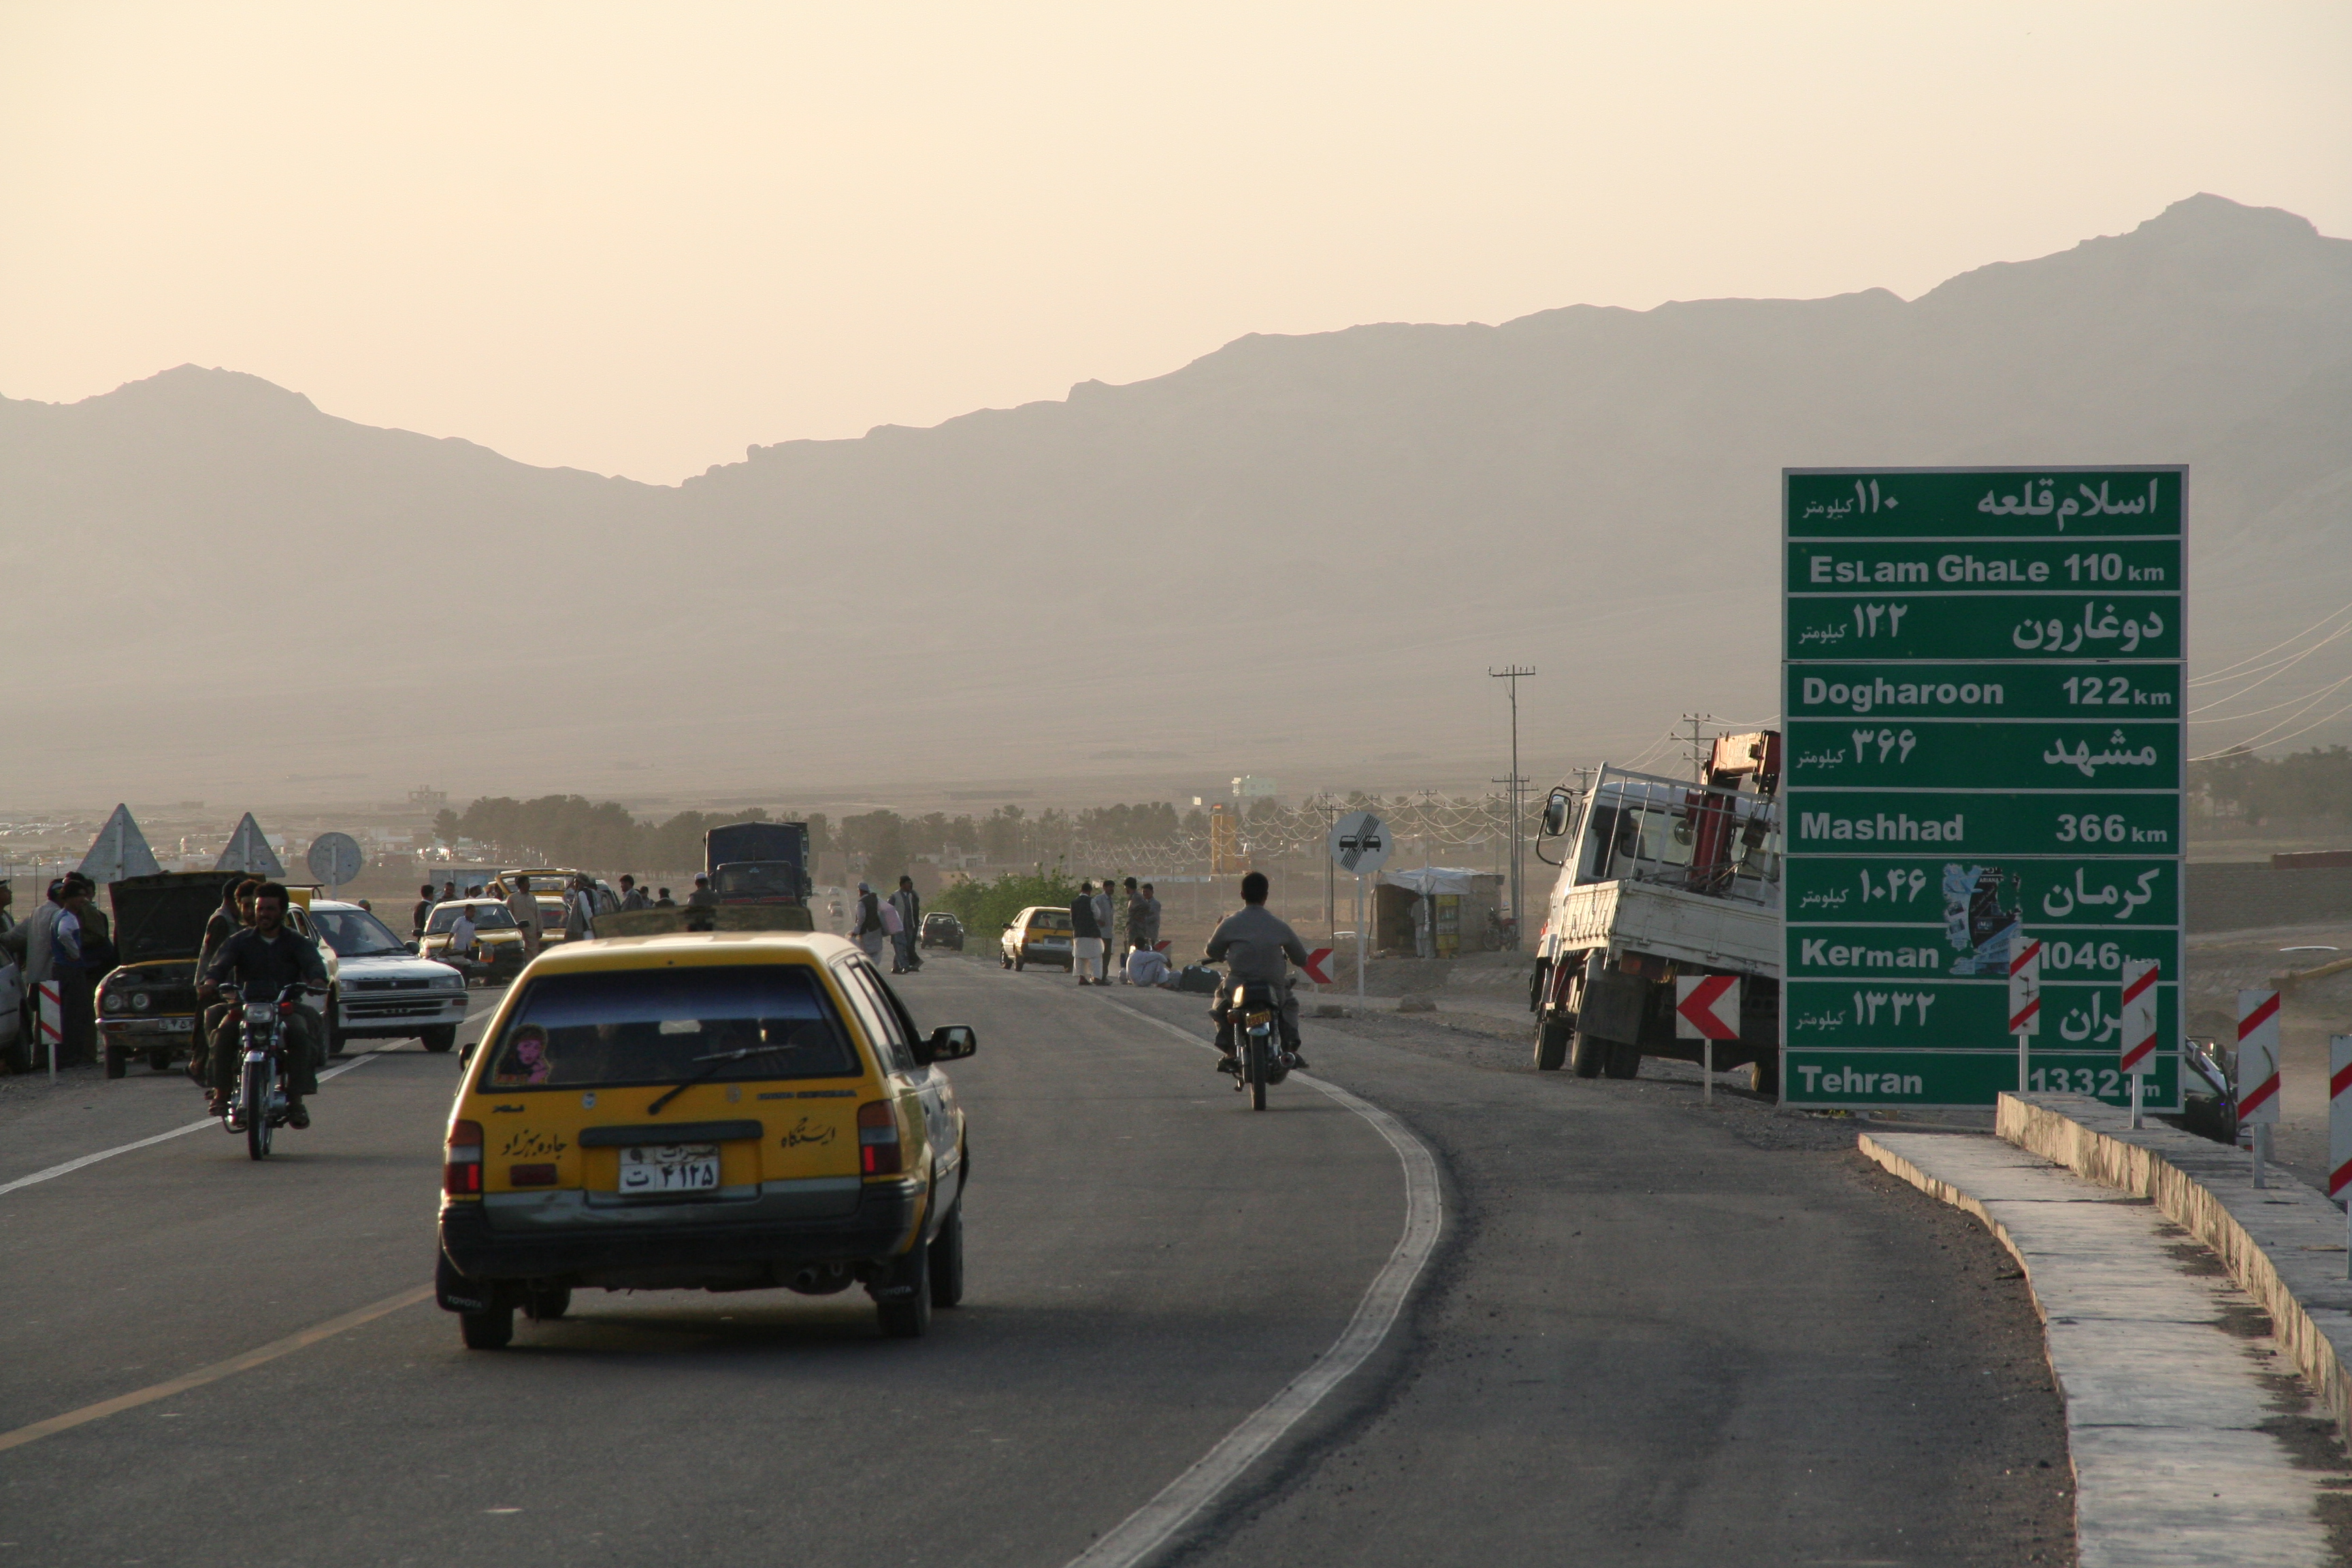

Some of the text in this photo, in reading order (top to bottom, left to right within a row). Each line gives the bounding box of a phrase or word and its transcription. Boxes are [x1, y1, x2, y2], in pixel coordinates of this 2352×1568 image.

[1803, 478, 2157, 531] اسلام قلعه ۱۱۰ کیلومتر
[2065, 553, 2122, 581] 110
[2129, 566, 2163, 581] km
[1799, 602, 2163, 652] دوغارون ۱۲۲ کیلومتر
[1803, 677, 2170, 712] Dogharoon 122 km
[1797, 729, 2156, 777] مشهد ۳۶۶ کیلومتر
[1801, 813, 2167, 842] Mashhad 366 km
[1800, 868, 2159, 918] کرمان ۱۰۴۶ کیلومتر
[1802, 938, 1938, 968] Kerman
[2040, 942, 2120, 969] 1046
[1796, 992, 2121, 1042] ران ۱۳۳۲ کیلومتر
[1798, 1066, 1922, 1093] Tehran
[2029, 1068, 2118, 1098] 1332
